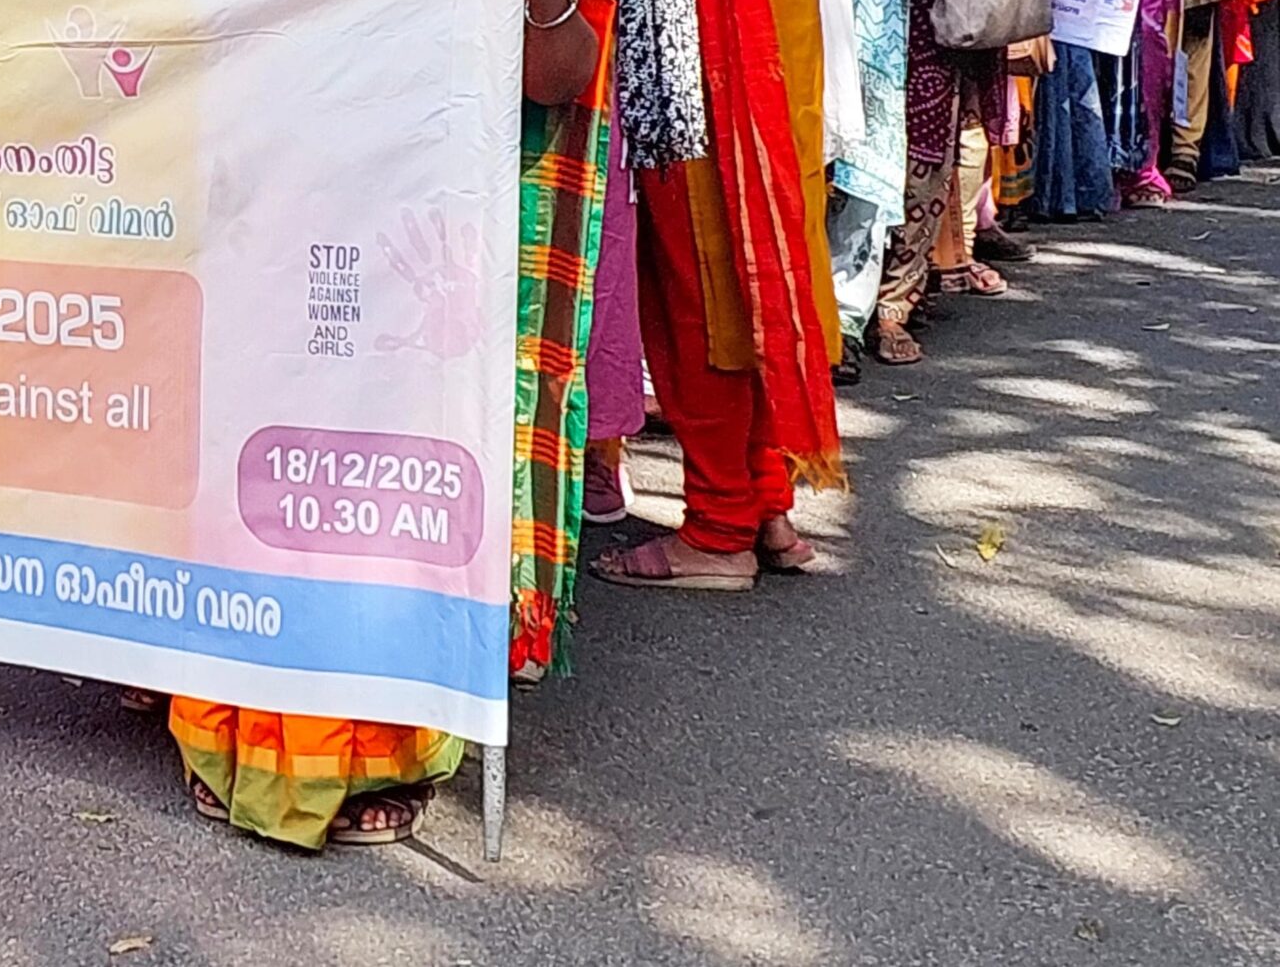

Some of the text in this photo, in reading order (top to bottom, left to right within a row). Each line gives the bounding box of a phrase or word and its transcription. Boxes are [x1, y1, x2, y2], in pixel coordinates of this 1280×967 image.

[6, 198, 83, 234] ഓഫ്
[91, 201, 175, 239] വിമൻ
[309, 245, 361, 271] STOP
[308, 271, 360, 287] VIOLENCE
[308, 287, 360, 304] AGAINST
[308, 304, 361, 323] WOMEN
[313, 325, 348, 341] AND
[307, 340, 355, 358] GIRLS
[106, 385, 151, 430] all
[265, 446, 462, 499] 18/12/2025
[278, 494, 449, 544] 10.30 AM
[55, 564, 190, 621] ഓഫീസ്
[197, 586, 282, 638] വരെ
